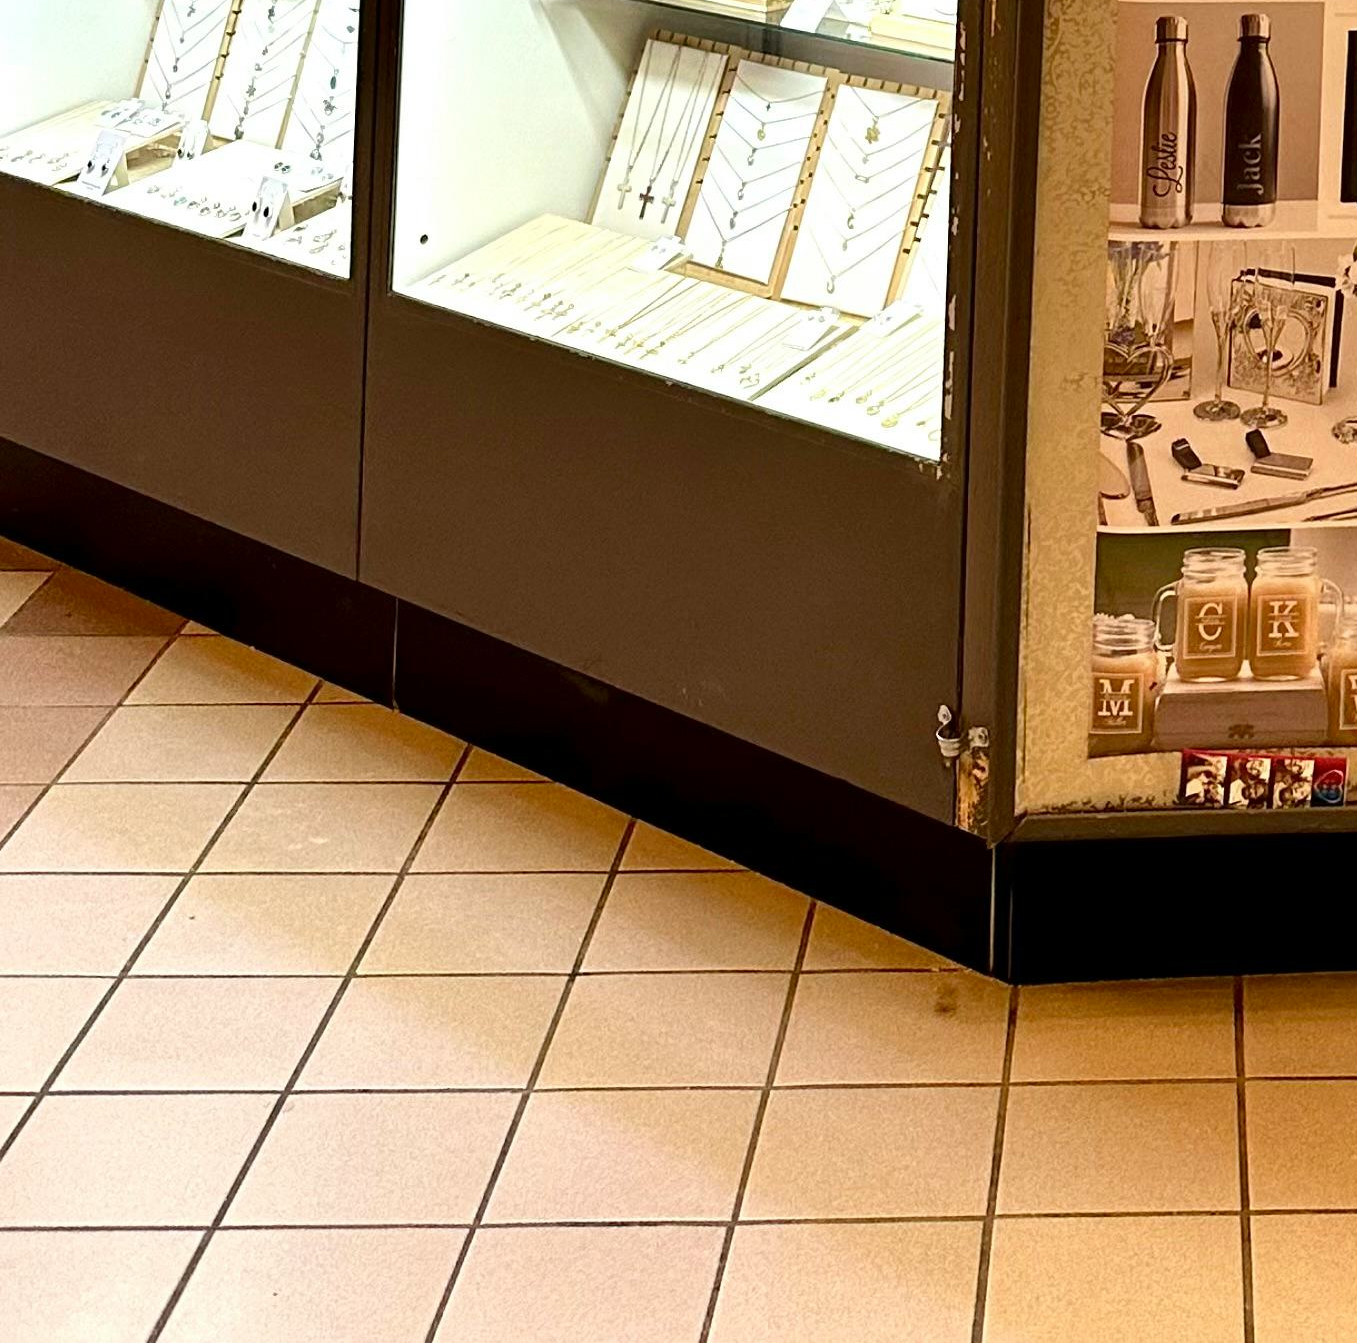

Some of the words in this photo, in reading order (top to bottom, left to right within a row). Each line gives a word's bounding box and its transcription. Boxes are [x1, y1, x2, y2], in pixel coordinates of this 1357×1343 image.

[1146, 132, 1184, 197] Leslie
[1236, 134, 1264, 195] Jack
[1268, 600, 1299, 638] K
[1097, 679, 1135, 716] M
